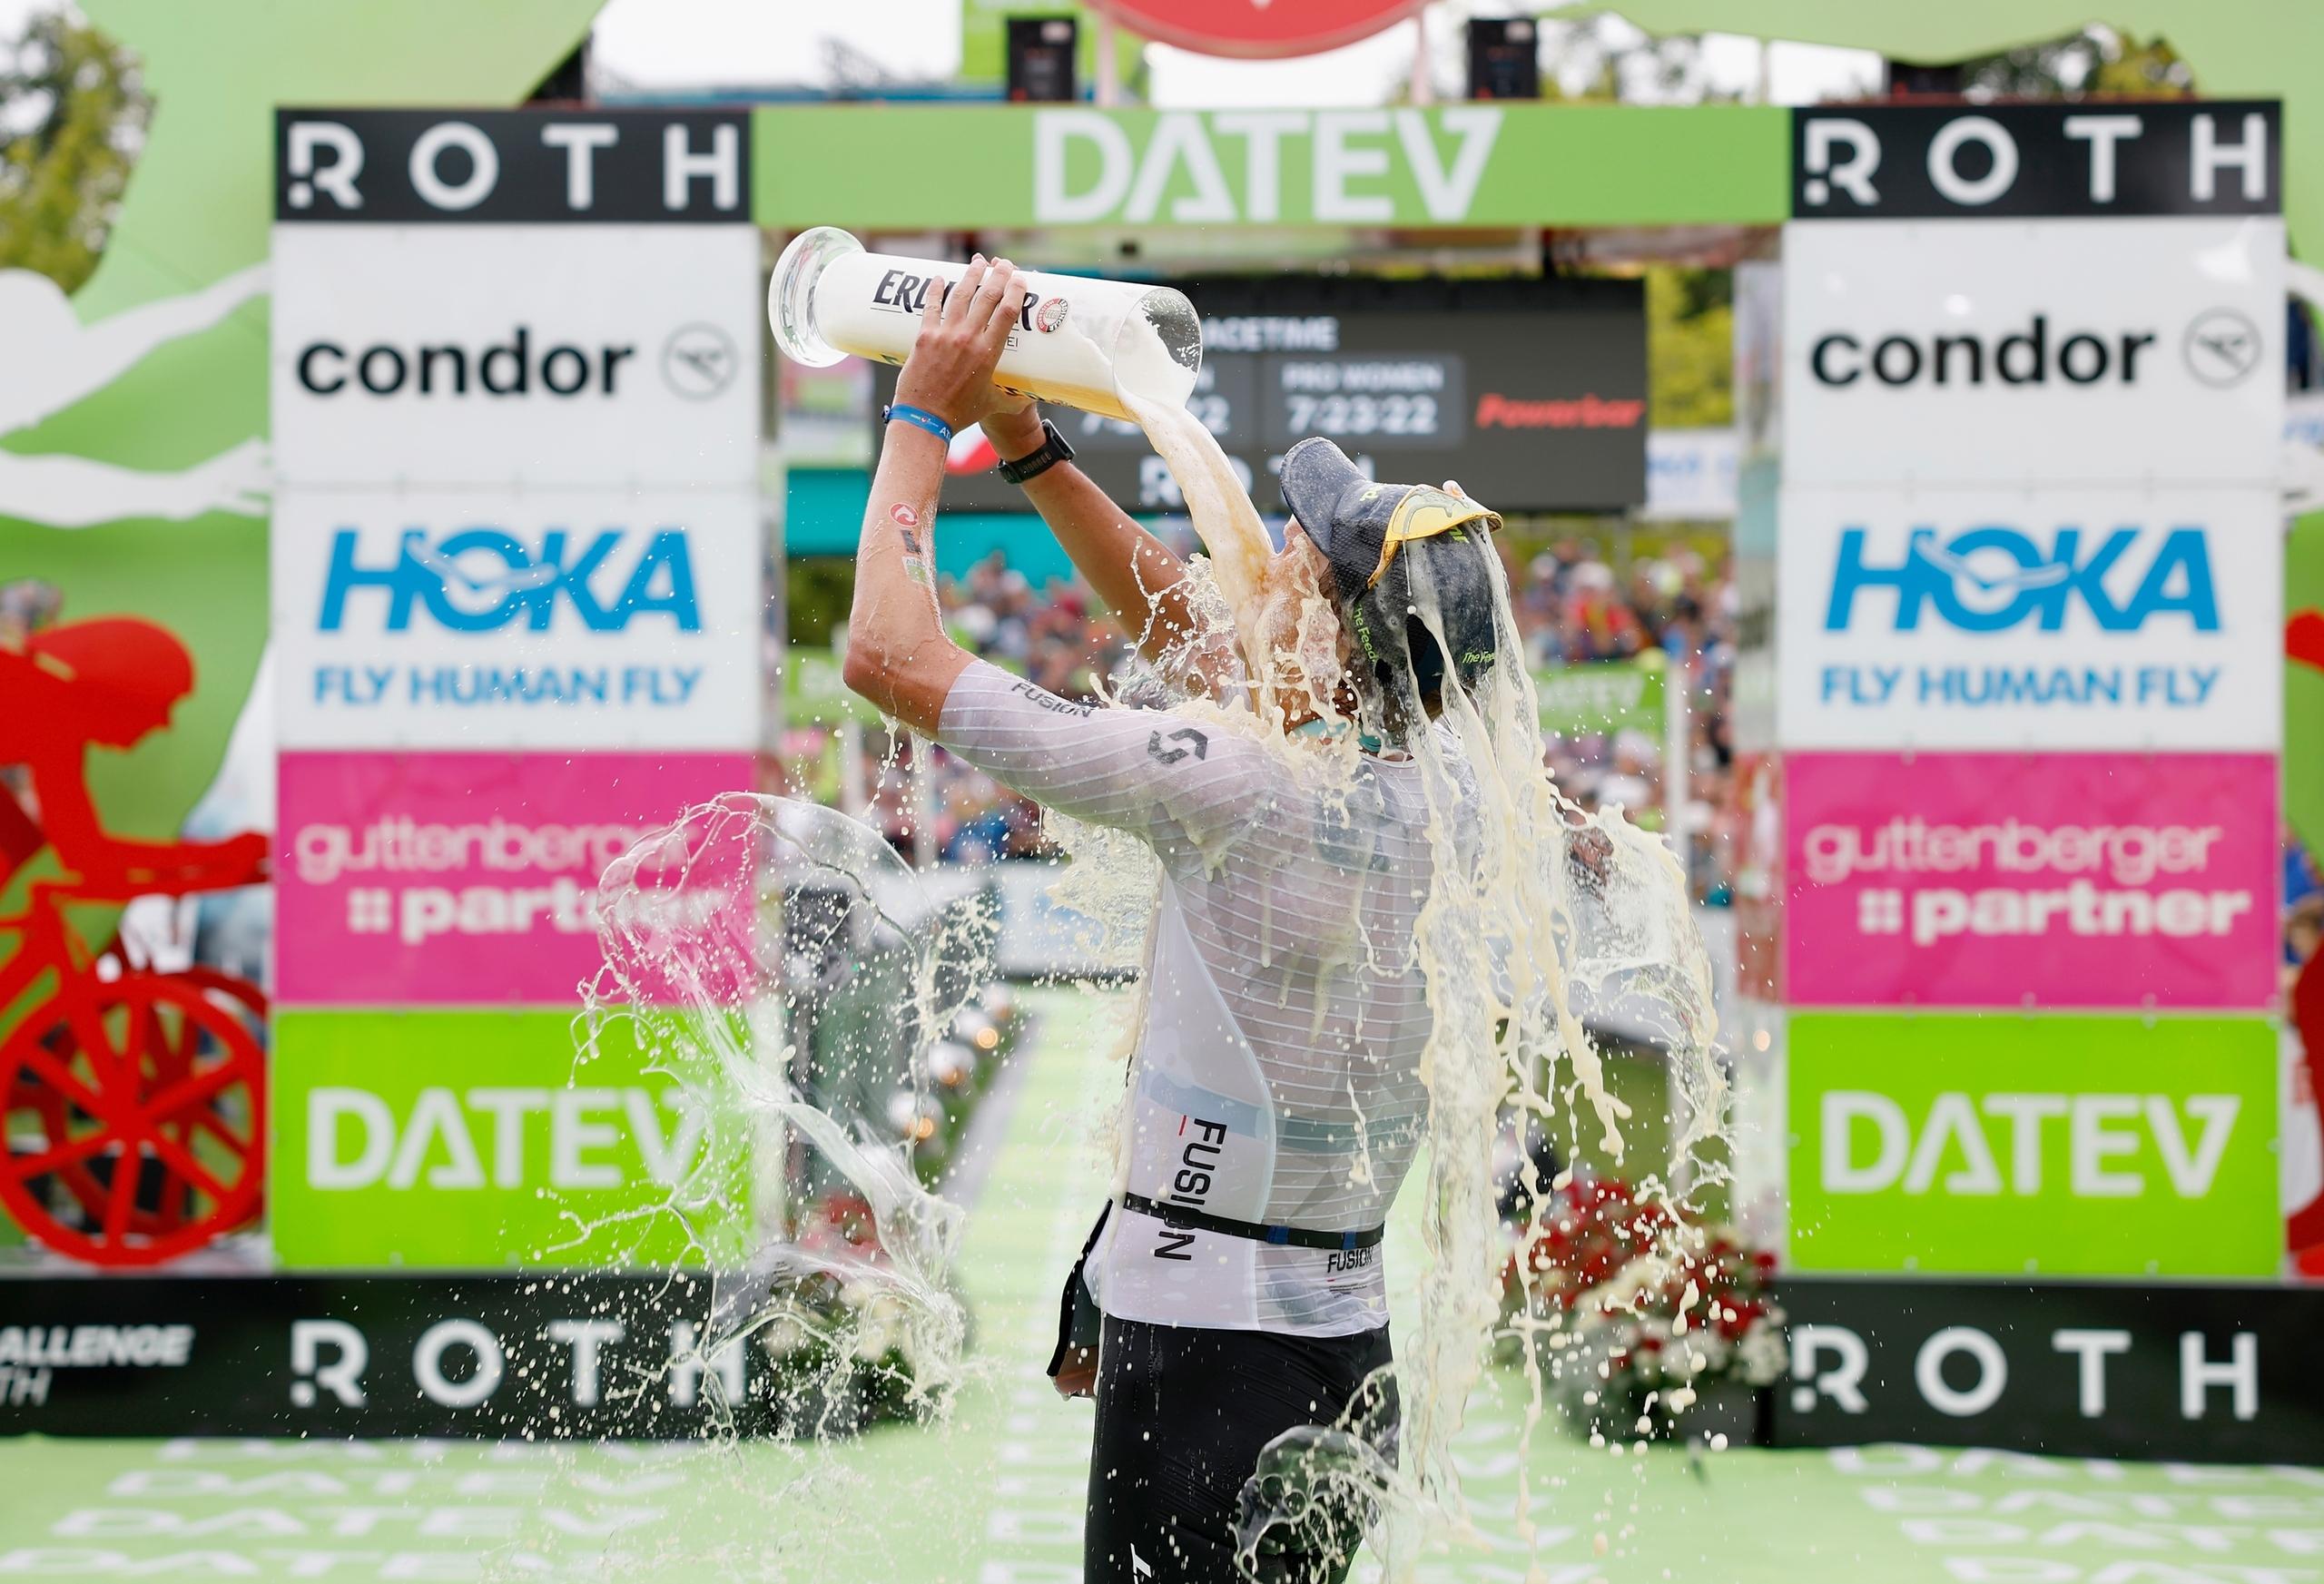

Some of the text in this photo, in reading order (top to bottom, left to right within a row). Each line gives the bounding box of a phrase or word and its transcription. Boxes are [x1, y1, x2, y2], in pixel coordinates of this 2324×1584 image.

[289, 122, 739, 210] ROTH
[1032, 111, 1505, 223] DATEV
[1804, 113, 2269, 205] ROTH
[296, 327, 635, 397] condor
[1201, 317, 1338, 351] ACETIME
[1342, 365, 1444, 390] WOMEN
[1809, 315, 2154, 388] condor
[318, 528, 702, 634] HOKA
[1823, 526, 2222, 634] HOKA
[313, 667, 702, 705] FLY HUMAN FLY
[1820, 666, 2221, 706] FLY HUMAN FLY
[1804, 816, 2224, 884] guttenberger
[1912, 879, 2253, 946] partner
[307, 1087, 713, 1190] DATEV
[1820, 1089, 2243, 1198] DATEV
[1154, 1117, 1228, 1262] FUSIN
[290, 1320, 750, 1407] ROTH
[1791, 1325, 2260, 1420] ROTH
